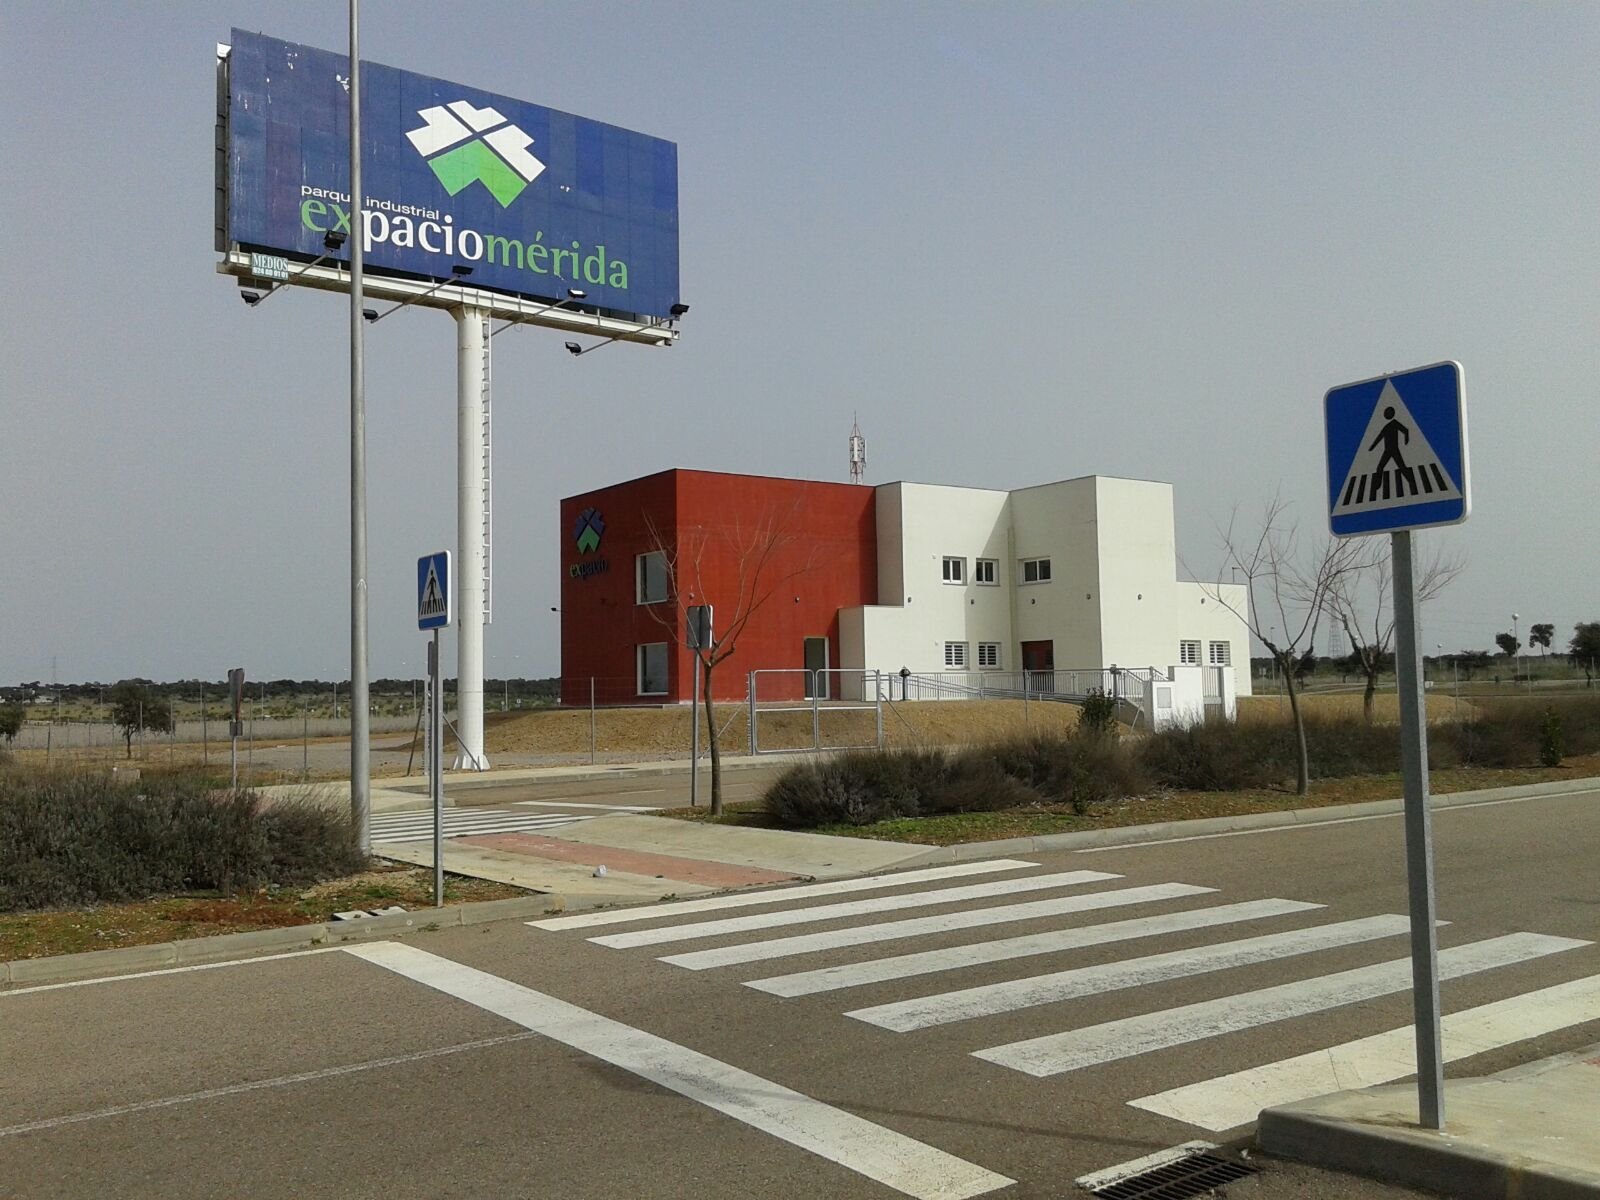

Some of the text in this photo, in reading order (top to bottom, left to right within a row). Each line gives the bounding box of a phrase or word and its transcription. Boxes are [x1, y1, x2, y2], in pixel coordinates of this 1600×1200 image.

[301, 185, 440, 221] parqu industrial
[252, 254, 288, 272] MEDIOS
